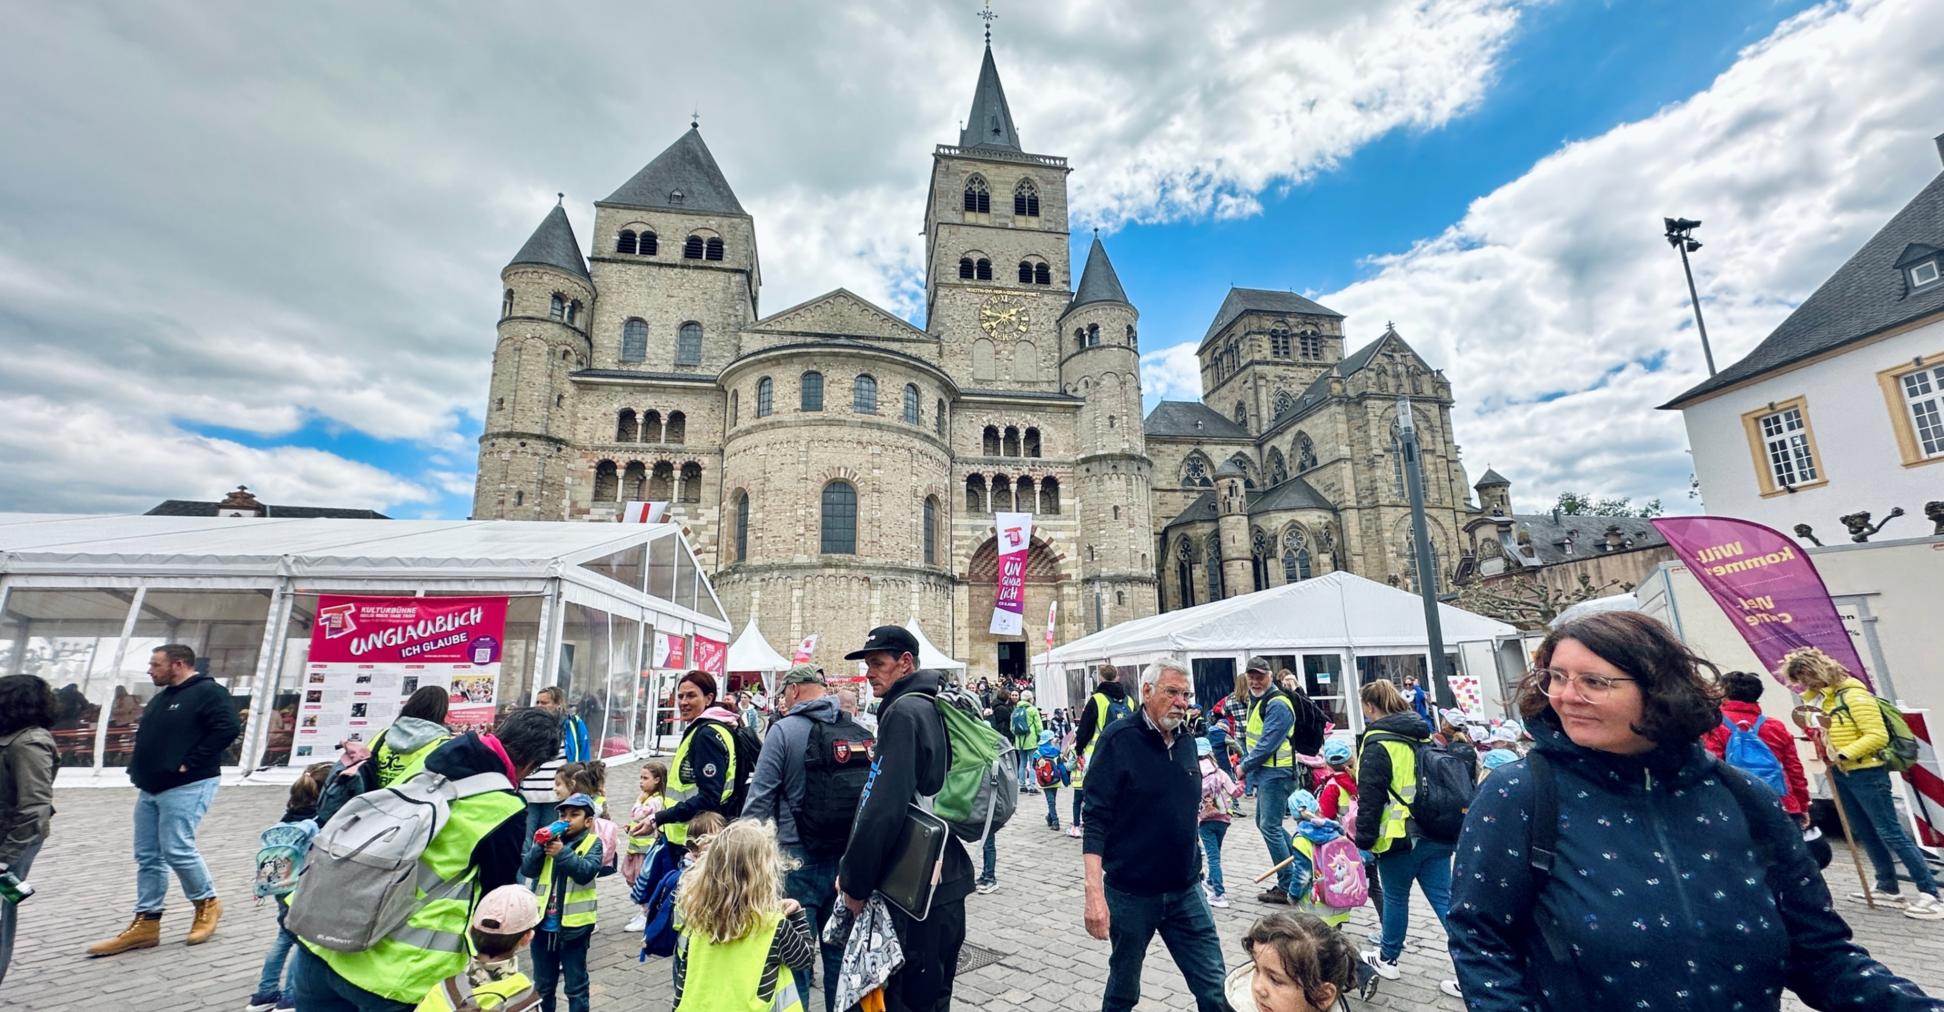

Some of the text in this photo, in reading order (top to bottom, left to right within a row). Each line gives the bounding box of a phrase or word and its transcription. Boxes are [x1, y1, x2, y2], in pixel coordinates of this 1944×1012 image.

[1004, 560, 1022, 577] UN
[360, 606, 417, 614] KULTURBÜHNE
[401, 646, 421, 658] ICH
[422, 632, 468, 652] GLAUBE
